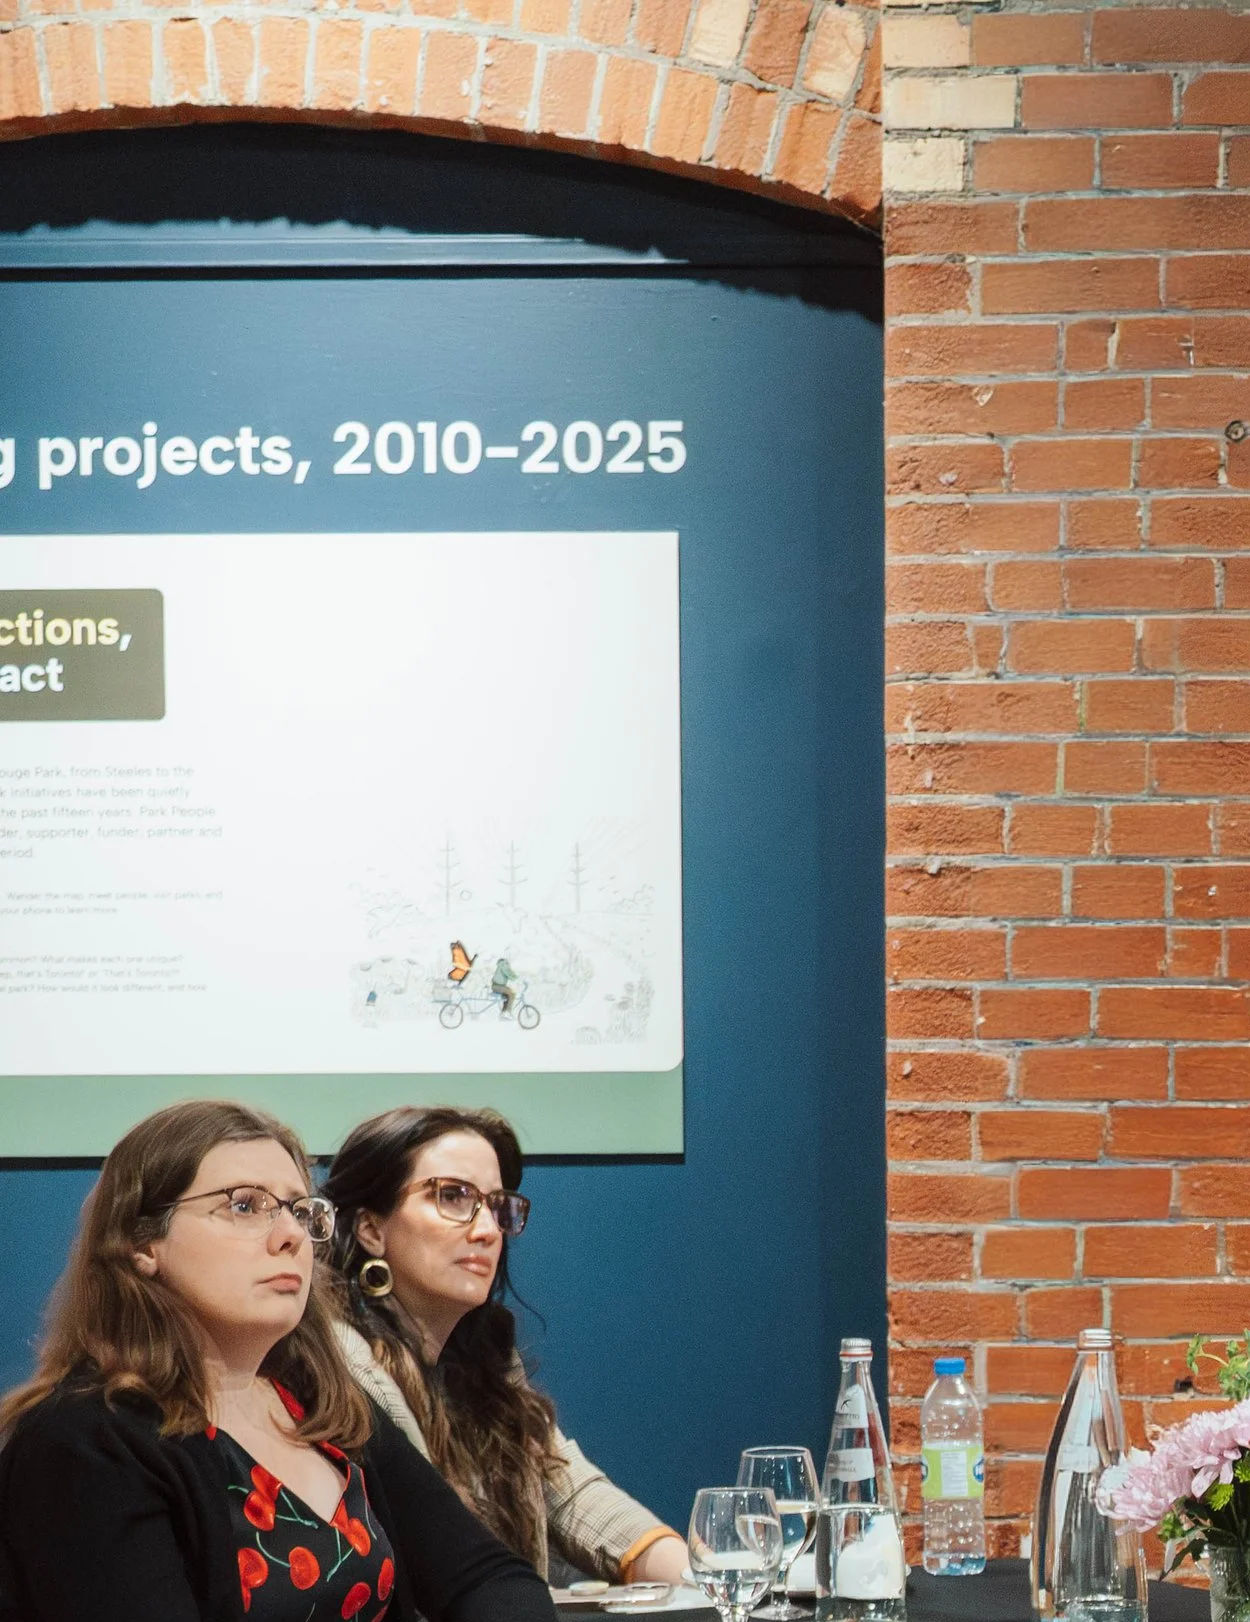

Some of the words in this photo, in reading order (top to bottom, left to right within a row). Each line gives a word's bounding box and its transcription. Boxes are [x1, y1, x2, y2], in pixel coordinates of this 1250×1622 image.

[38, 422, 311, 490] projects,
[70, 766, 102, 778] from
[105, 766, 153, 778] Steeles
[156, 767, 170, 778] to
[173, 766, 195, 778] the
[77, 787, 107, 798] have
[111, 786, 145, 798] been
